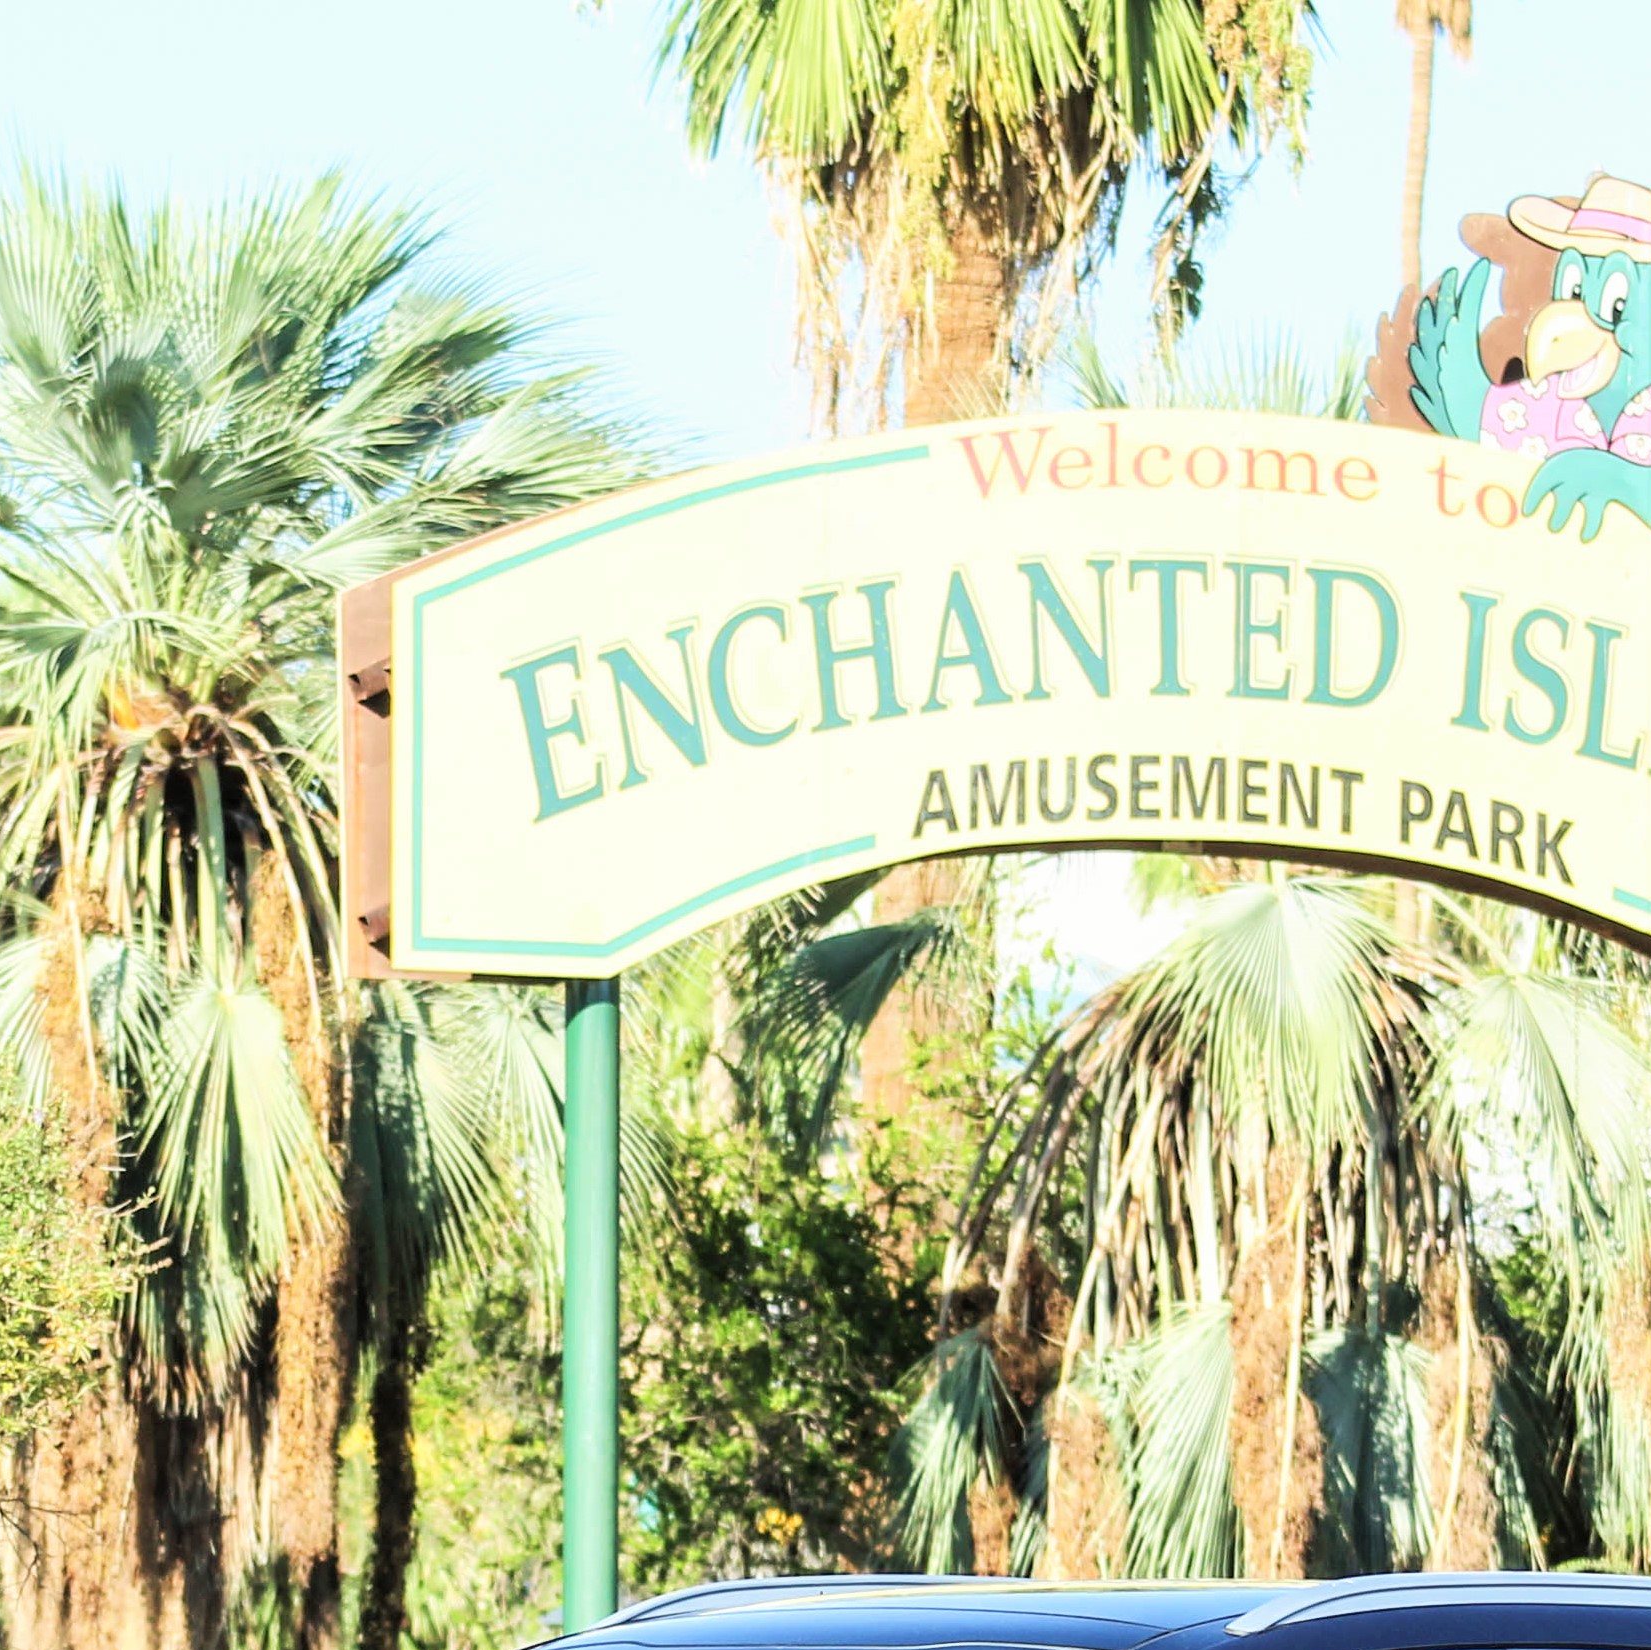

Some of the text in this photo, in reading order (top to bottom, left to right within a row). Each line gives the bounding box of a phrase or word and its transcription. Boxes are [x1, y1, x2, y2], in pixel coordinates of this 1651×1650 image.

[953, 421, 1520, 529] Welcome to
[498, 554, 1403, 824] ENCHANTED
[911, 753, 1575, 887] AMUSEMENT PARK
